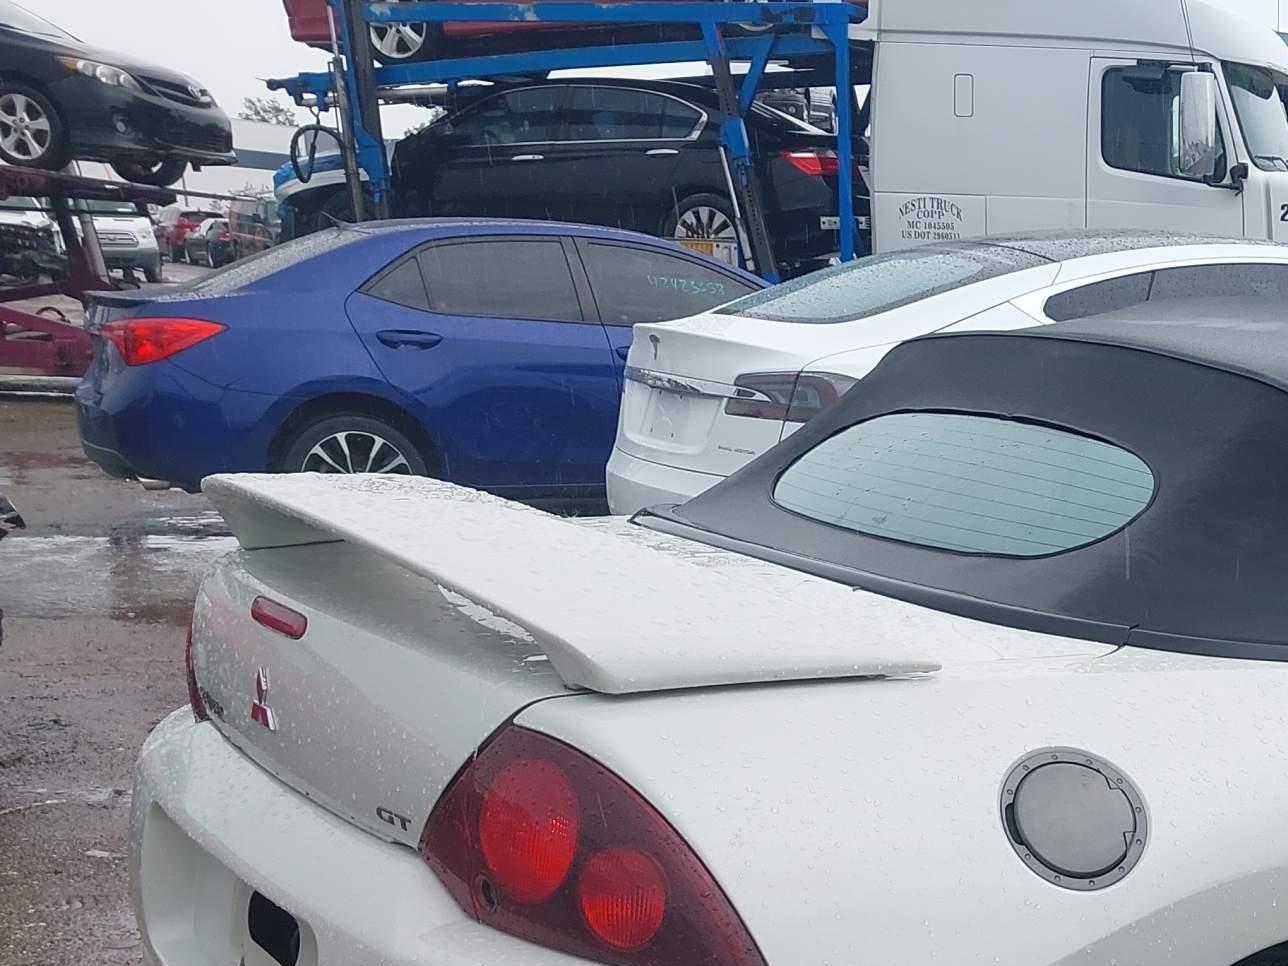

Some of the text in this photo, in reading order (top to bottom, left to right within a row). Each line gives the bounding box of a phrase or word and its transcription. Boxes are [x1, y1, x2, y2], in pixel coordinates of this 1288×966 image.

[929, 197, 963, 222] TRUCK
[907, 220, 921, 229] MC
[902, 230, 912, 239] US
[914, 230, 931, 239] DOT
[376, 806, 412, 832] GT
